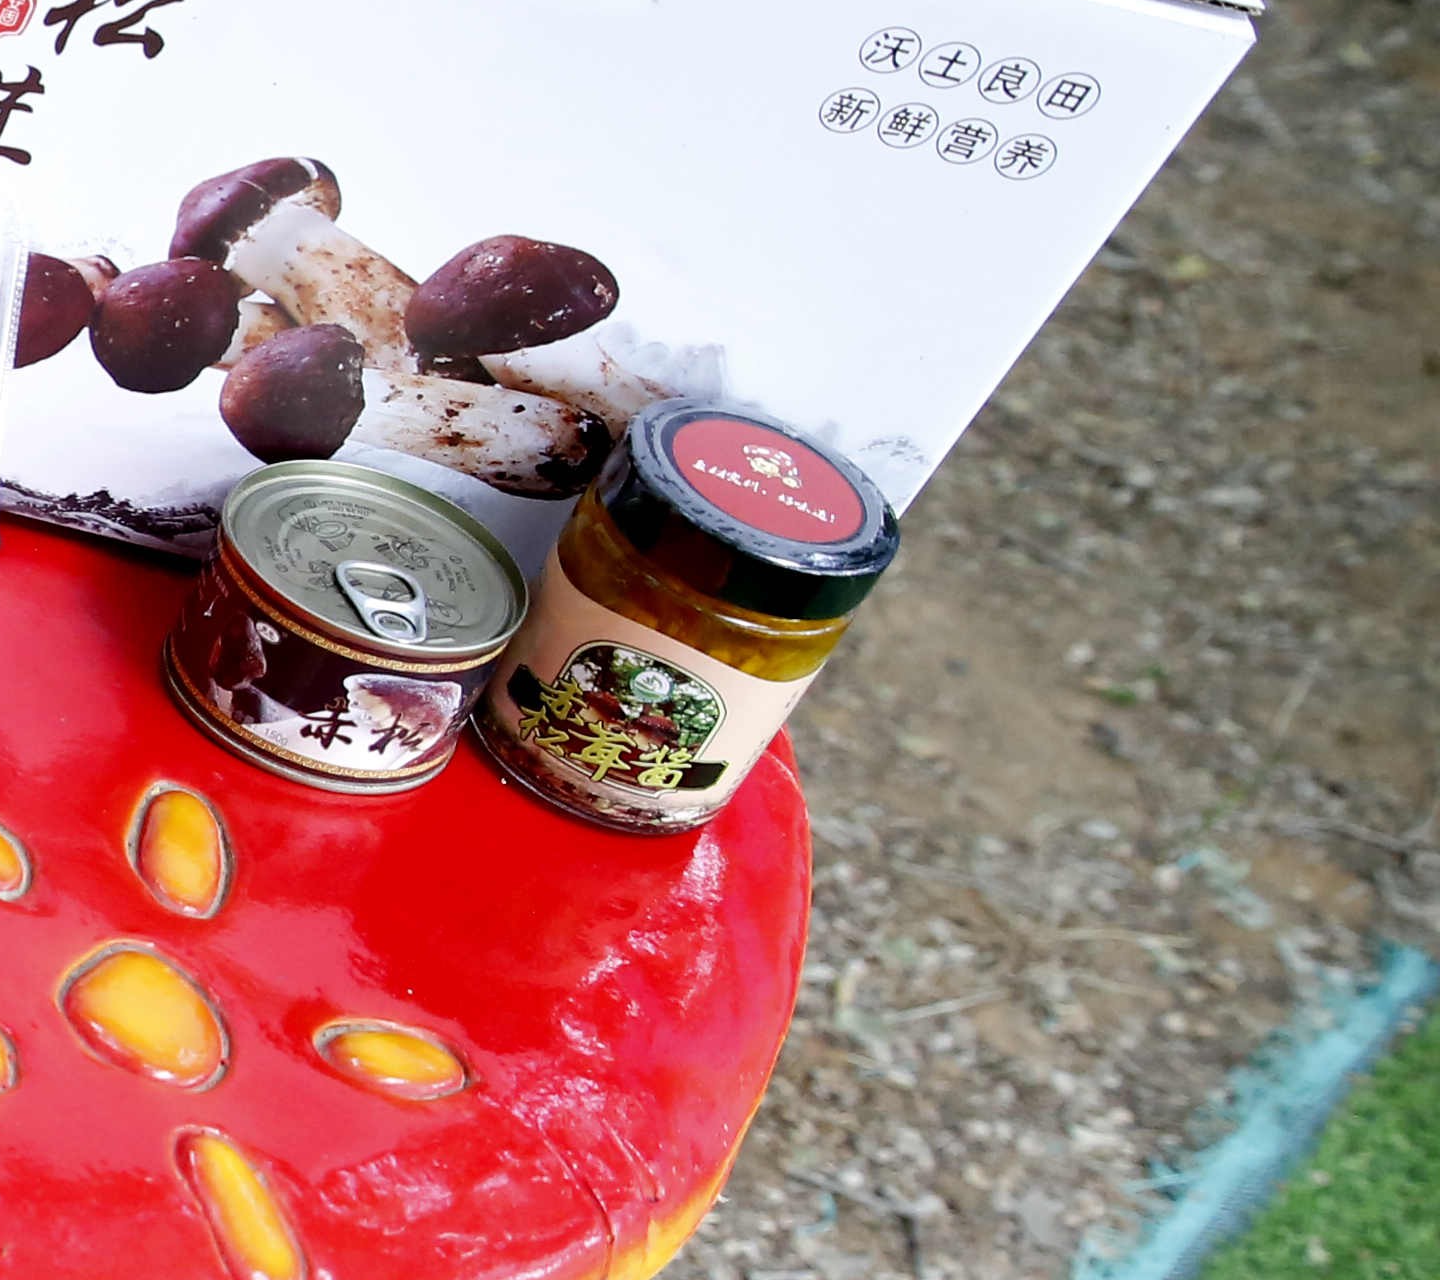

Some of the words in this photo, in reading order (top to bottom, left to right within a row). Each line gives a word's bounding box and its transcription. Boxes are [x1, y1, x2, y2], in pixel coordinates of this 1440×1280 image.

[863, 31, 1094, 116] 沃土良田
[822, 90, 1052, 176] 新鲜营养
